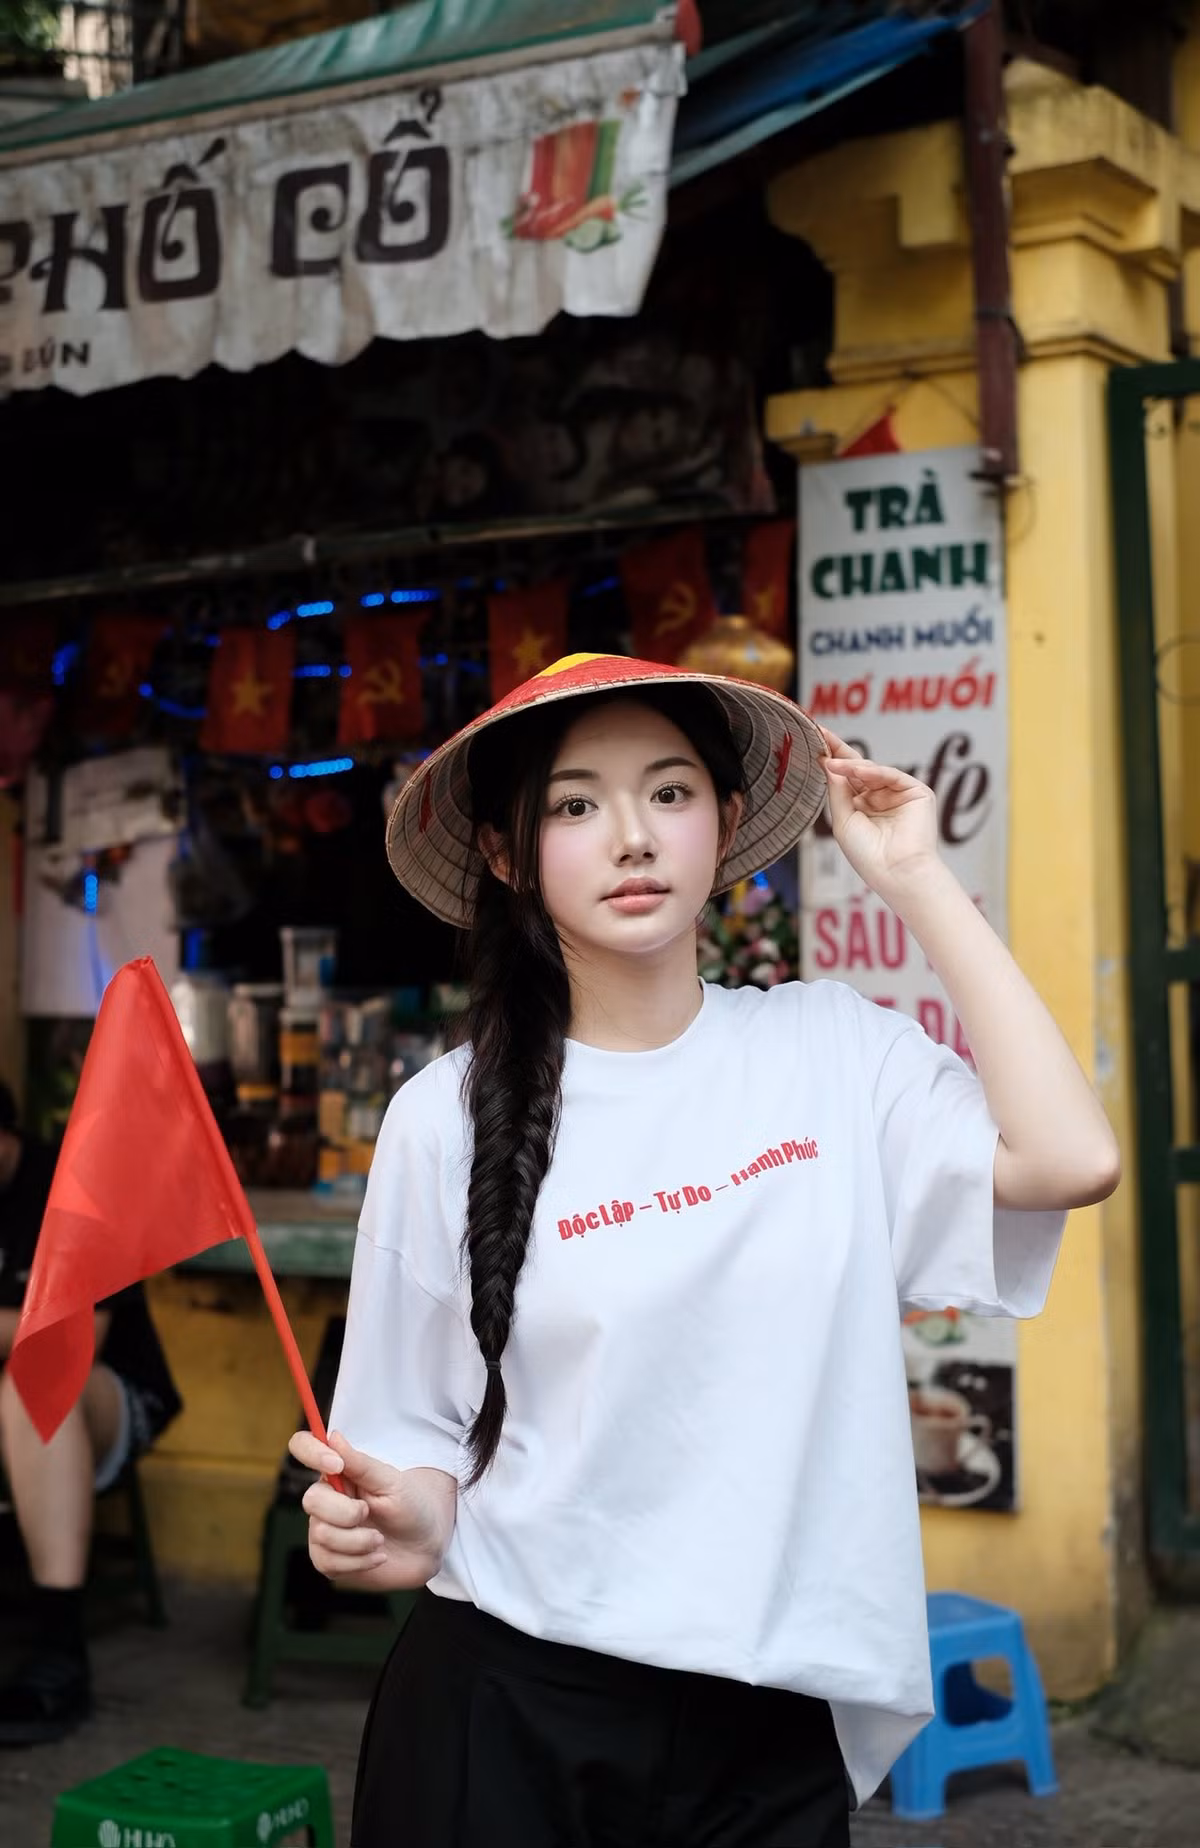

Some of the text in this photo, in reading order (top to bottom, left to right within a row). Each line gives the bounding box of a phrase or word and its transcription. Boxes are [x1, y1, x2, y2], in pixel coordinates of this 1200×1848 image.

[268, 86, 452, 279] CỔ
[843, 469, 944, 533] TRÀ
[810, 542, 989, 600] CHANH
[808, 606, 994, 658] CHANH MUỐI
[879, 657, 996, 713] MUỐI
[557, 1205, 600, 1240] Độc
[598, 1200, 635, 1227] Lập
[653, 1190, 682, 1214] Tự
[682, 1185, 712, 1207] Do
[780, 1136, 819, 1163] Phúc
